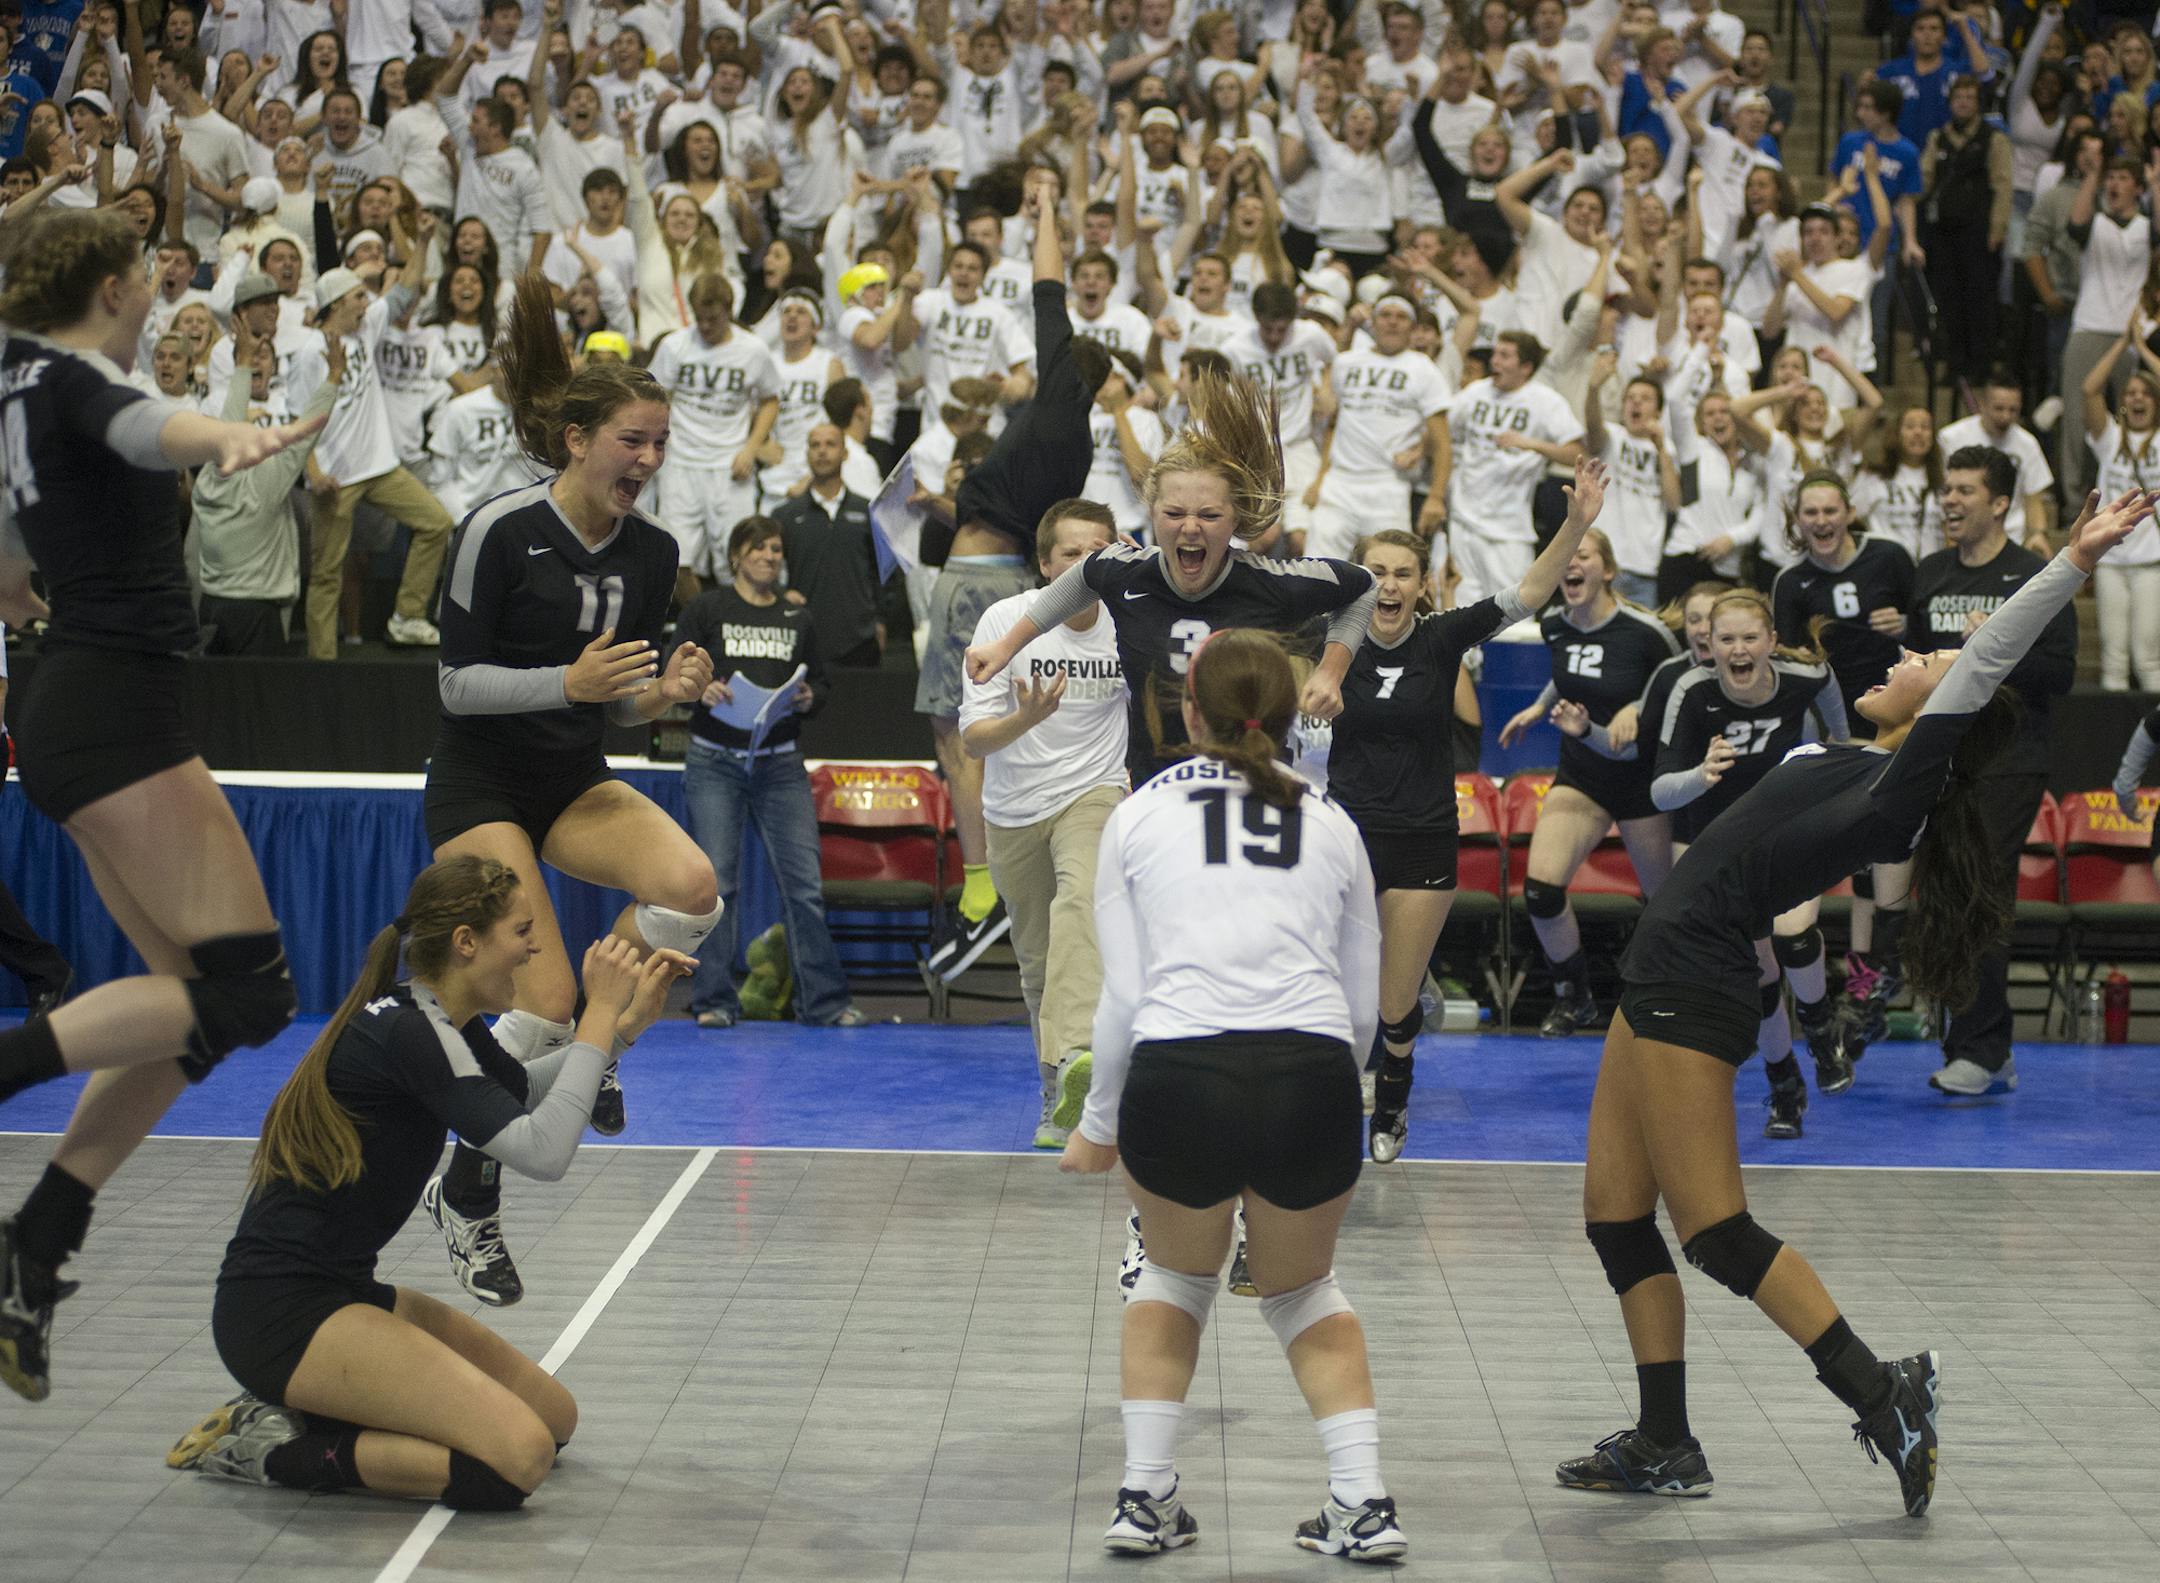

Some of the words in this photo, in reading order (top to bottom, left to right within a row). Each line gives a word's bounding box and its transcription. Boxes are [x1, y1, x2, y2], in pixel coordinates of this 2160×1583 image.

[982, 278, 1019, 299] VB
[676, 363, 747, 392] RVB
[1247, 352, 1308, 386] RVB
[1344, 366, 1409, 390] RVB
[780, 380, 818, 403] VB
[478, 417, 513, 441] RV
[1472, 400, 1531, 431] RVB
[574, 574, 625, 633] 11
[1833, 582, 1861, 619] 6
[722, 623, 798, 646] ROSEVILLE
[1931, 612, 1968, 633] RAID
[725, 639, 793, 662] RAIDERS
[1169, 618, 1212, 675] 3
[1565, 644, 1604, 679] 12
[1375, 665, 1404, 699] 7
[1725, 717, 1782, 755] 27
[1187, 786, 1303, 870] 19
